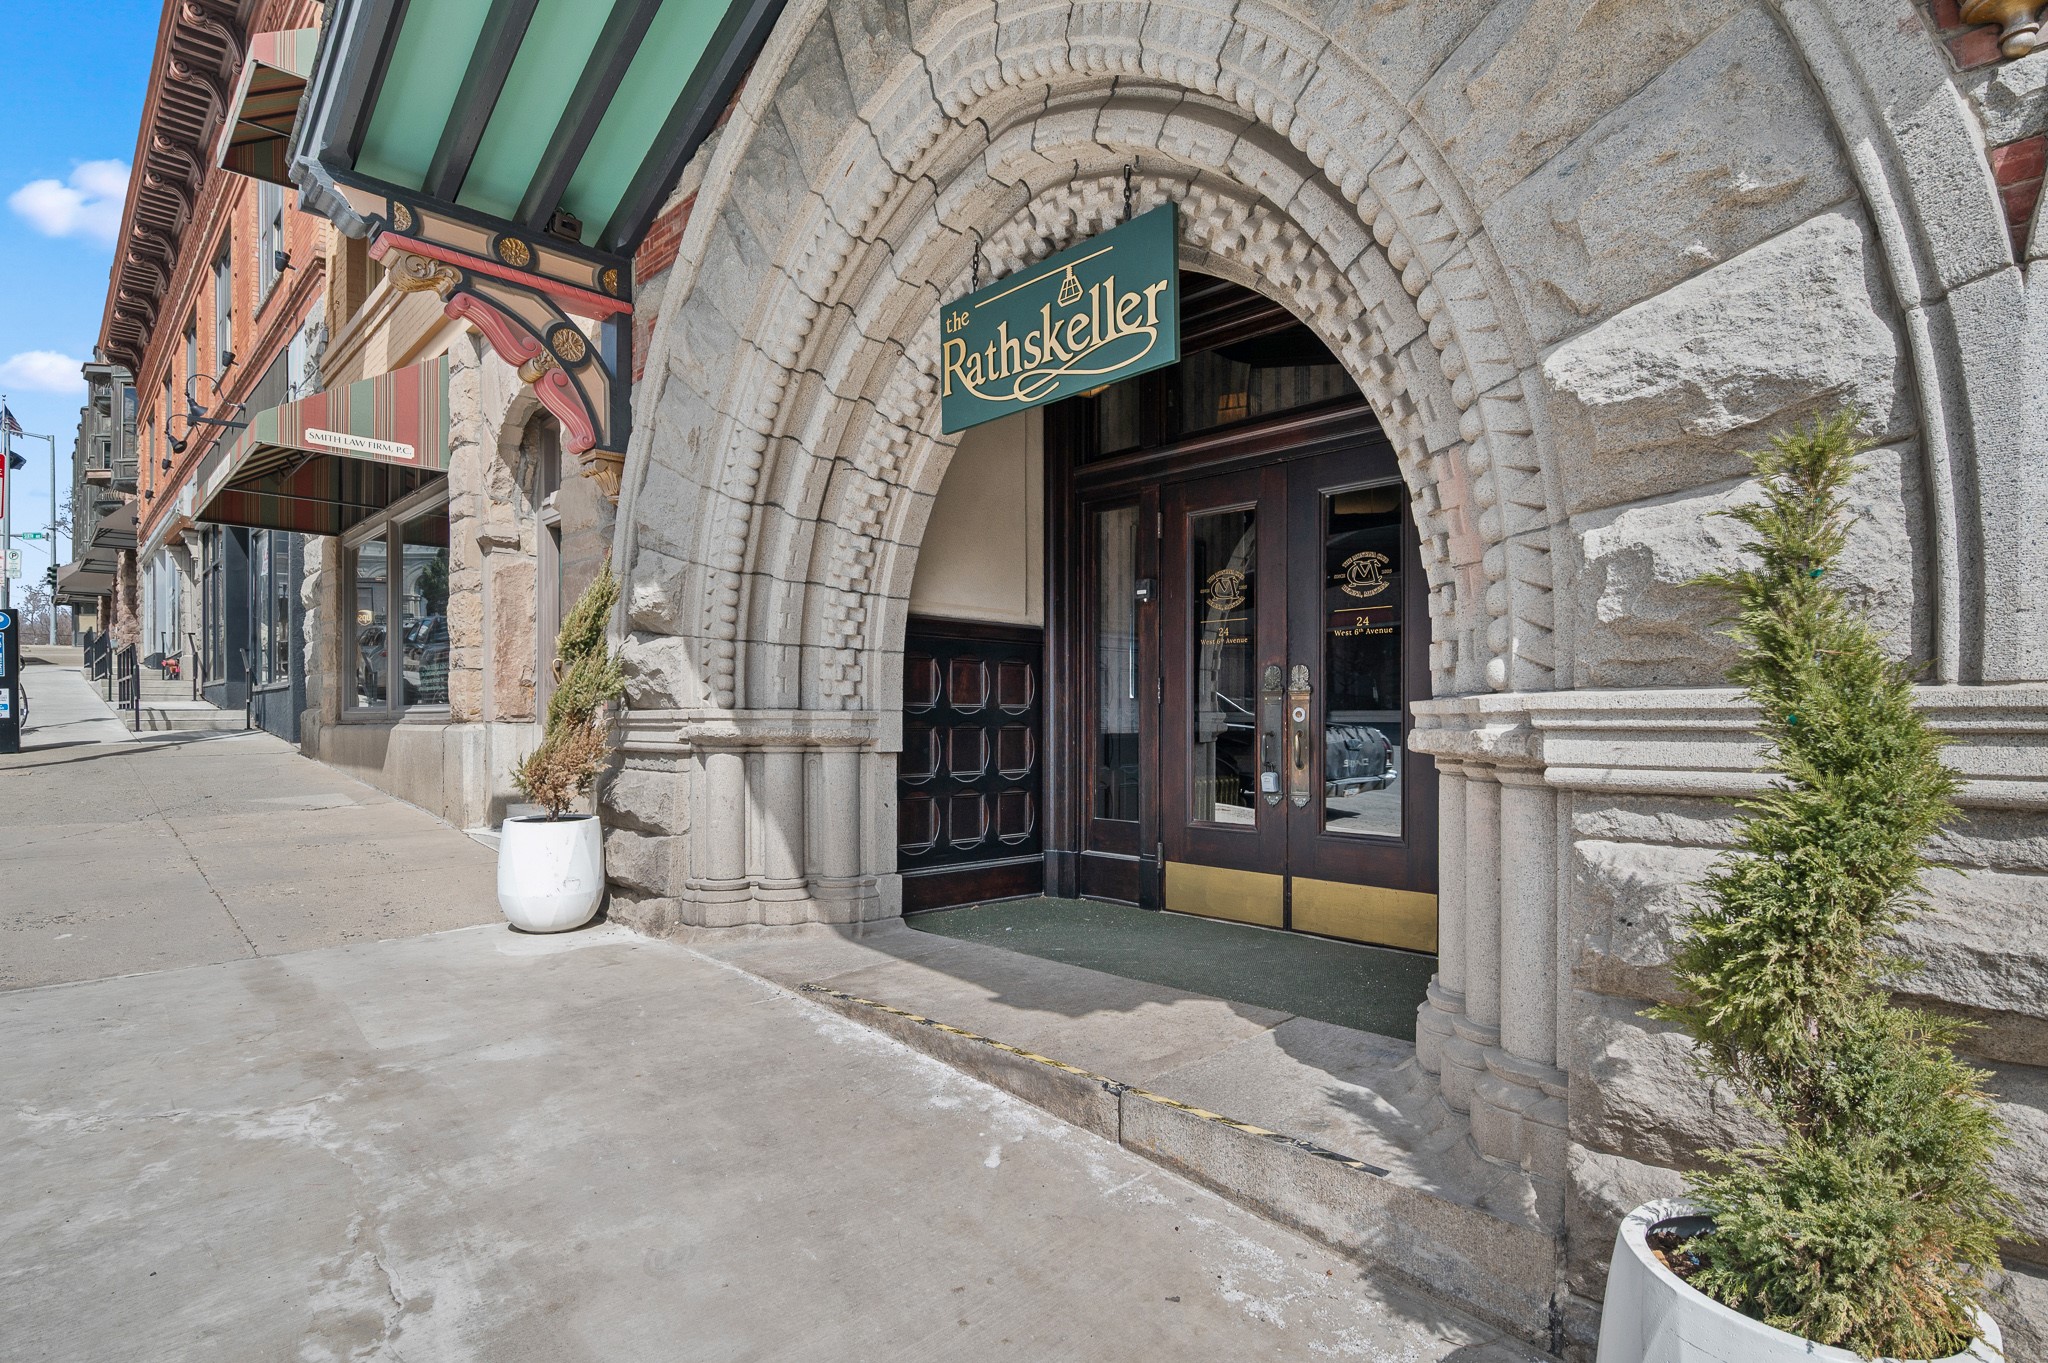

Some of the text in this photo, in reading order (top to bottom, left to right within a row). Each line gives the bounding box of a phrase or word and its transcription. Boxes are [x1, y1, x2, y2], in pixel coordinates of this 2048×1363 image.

[945, 310, 970, 335] the
[942, 275, 1168, 402] Rathskeller
[308, 431, 412, 456] SMITH LAW FIRM, P.C.
[1356, 616, 1370, 627] 24
[1218, 627, 1230, 637] 24
[1334, 629, 1352, 637] West
[1365, 627, 1393, 635] Avenue
